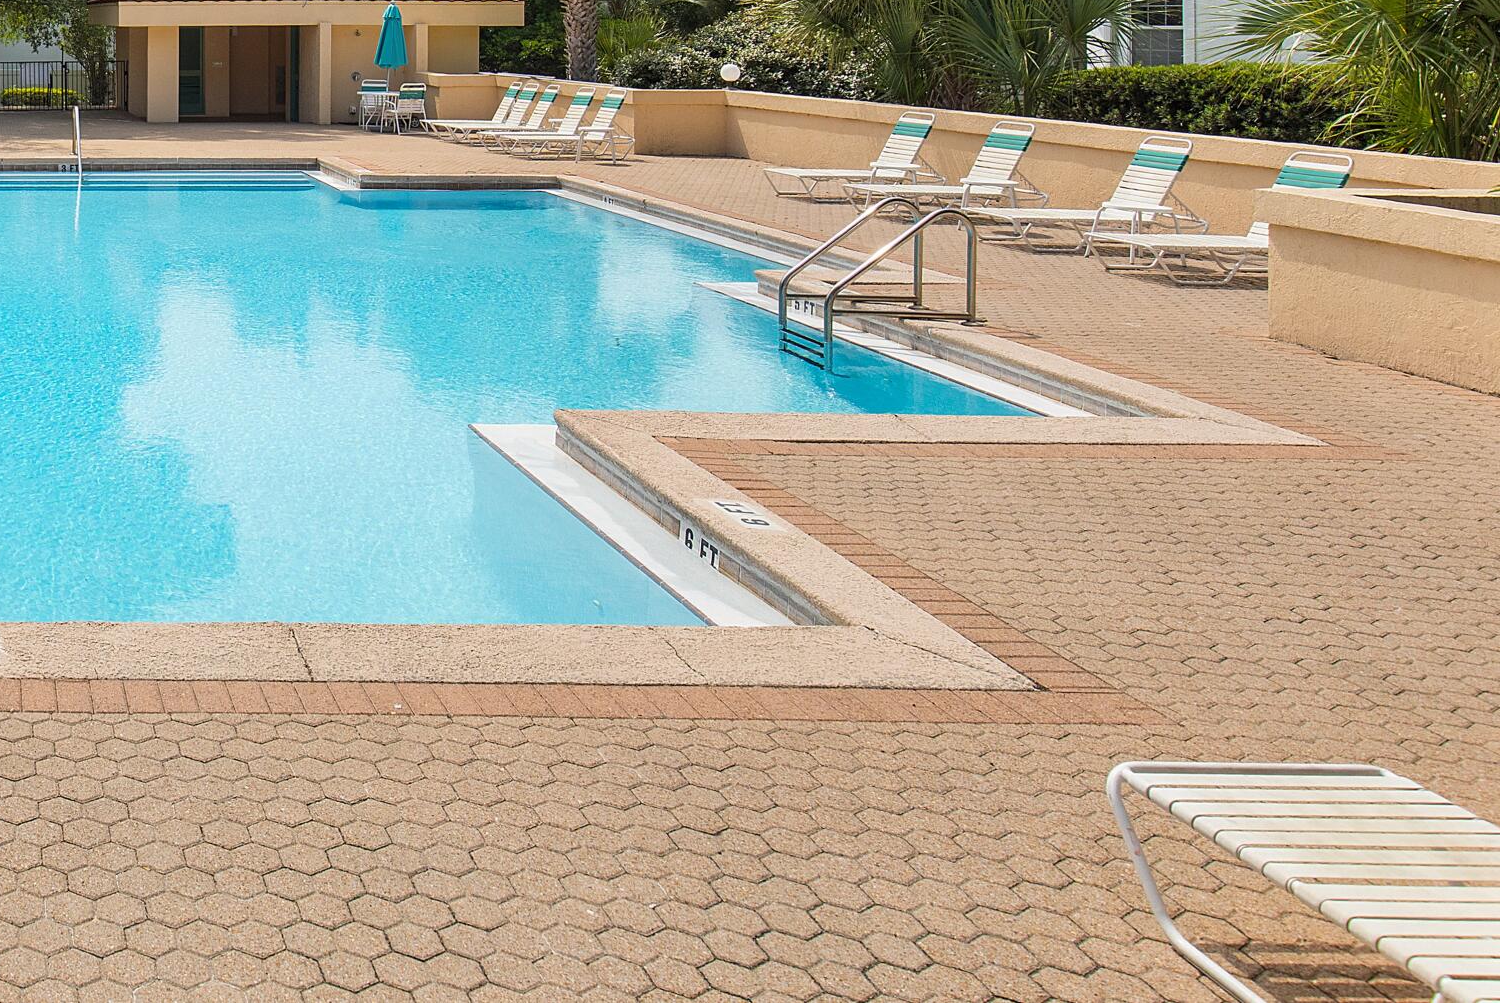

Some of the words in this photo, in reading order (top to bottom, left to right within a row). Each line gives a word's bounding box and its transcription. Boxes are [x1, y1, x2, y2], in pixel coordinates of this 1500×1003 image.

[61, 164, 67, 173] 3
[794, 300, 800, 311] 5
[684, 527, 694, 550] 6
